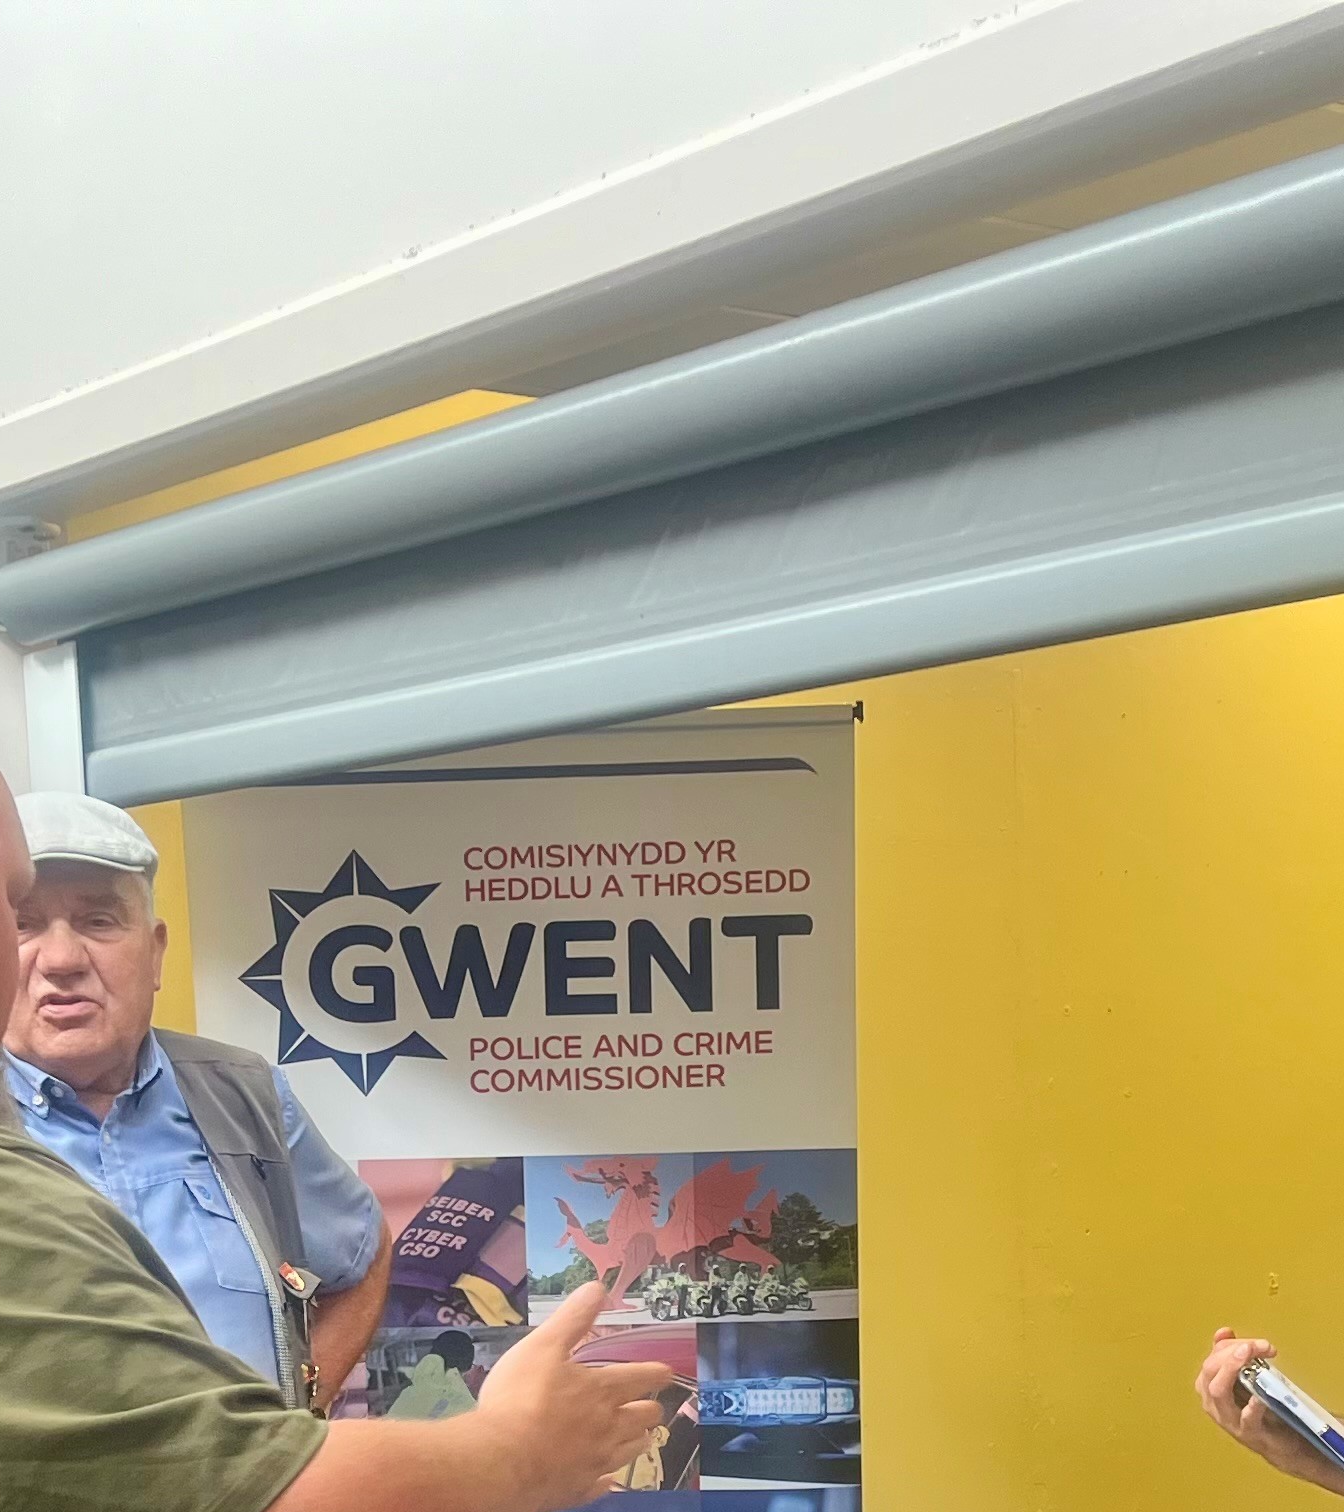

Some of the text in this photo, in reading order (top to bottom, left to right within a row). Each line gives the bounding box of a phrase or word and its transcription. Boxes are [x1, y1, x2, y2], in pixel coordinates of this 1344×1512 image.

[463, 839, 737, 872] COMISIYNYDD YR
[464, 869, 811, 903] HEDDLU A THROSEDD
[308, 914, 814, 1024] GWENT
[469, 1030, 774, 1063] POLICE AND CRIME
[469, 1064, 726, 1095] COMMISSIONER
[424, 1196, 495, 1222] SEIBER
[426, 1210, 468, 1228] SCC
[398, 1242, 441, 1258] CSO
[400, 1228, 468, 1251] CYBER
